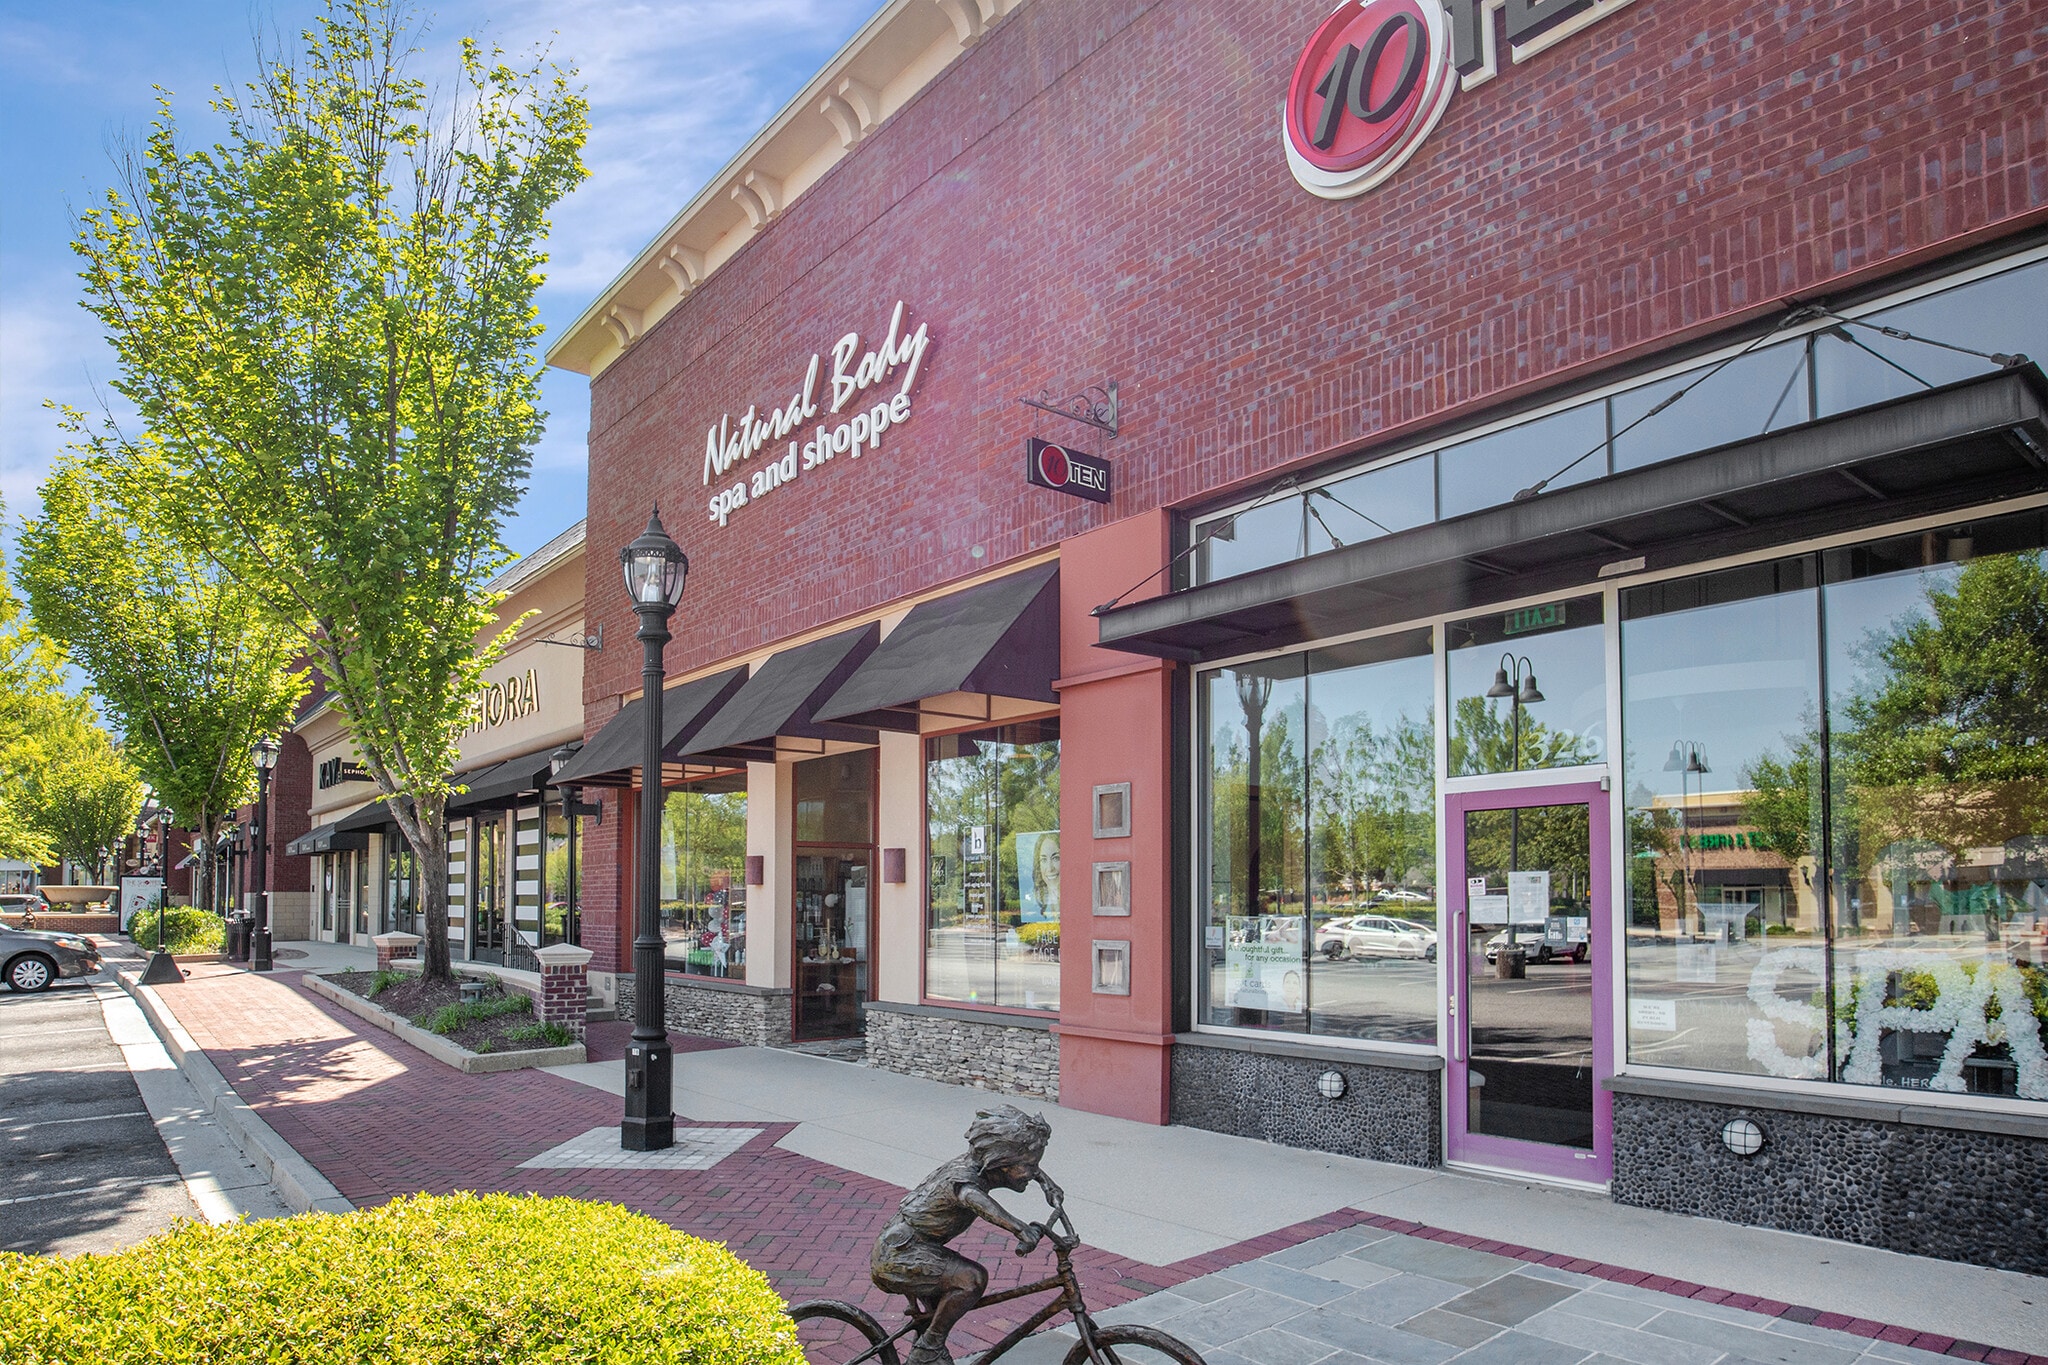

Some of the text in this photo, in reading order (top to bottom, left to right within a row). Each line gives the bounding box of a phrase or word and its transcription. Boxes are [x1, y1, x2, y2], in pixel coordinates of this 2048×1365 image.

[1312, 12, 1427, 150] 10
[703, 300, 930, 486] Natural Body
[708, 482, 748, 527] spa
[751, 441, 798, 499] and
[1068, 460, 1107, 492] TEN
[460, 668, 540, 738] HORA
[1528, 720, 1605, 766] 326
[319, 756, 341, 790] KAY
[343, 768, 366, 776] SEPHO
[1033, 948, 1055, 962] FACE
[1245, 953, 1255, 961] for
[1256, 955, 1269, 964] any
[1745, 946, 2048, 1101] SPA
